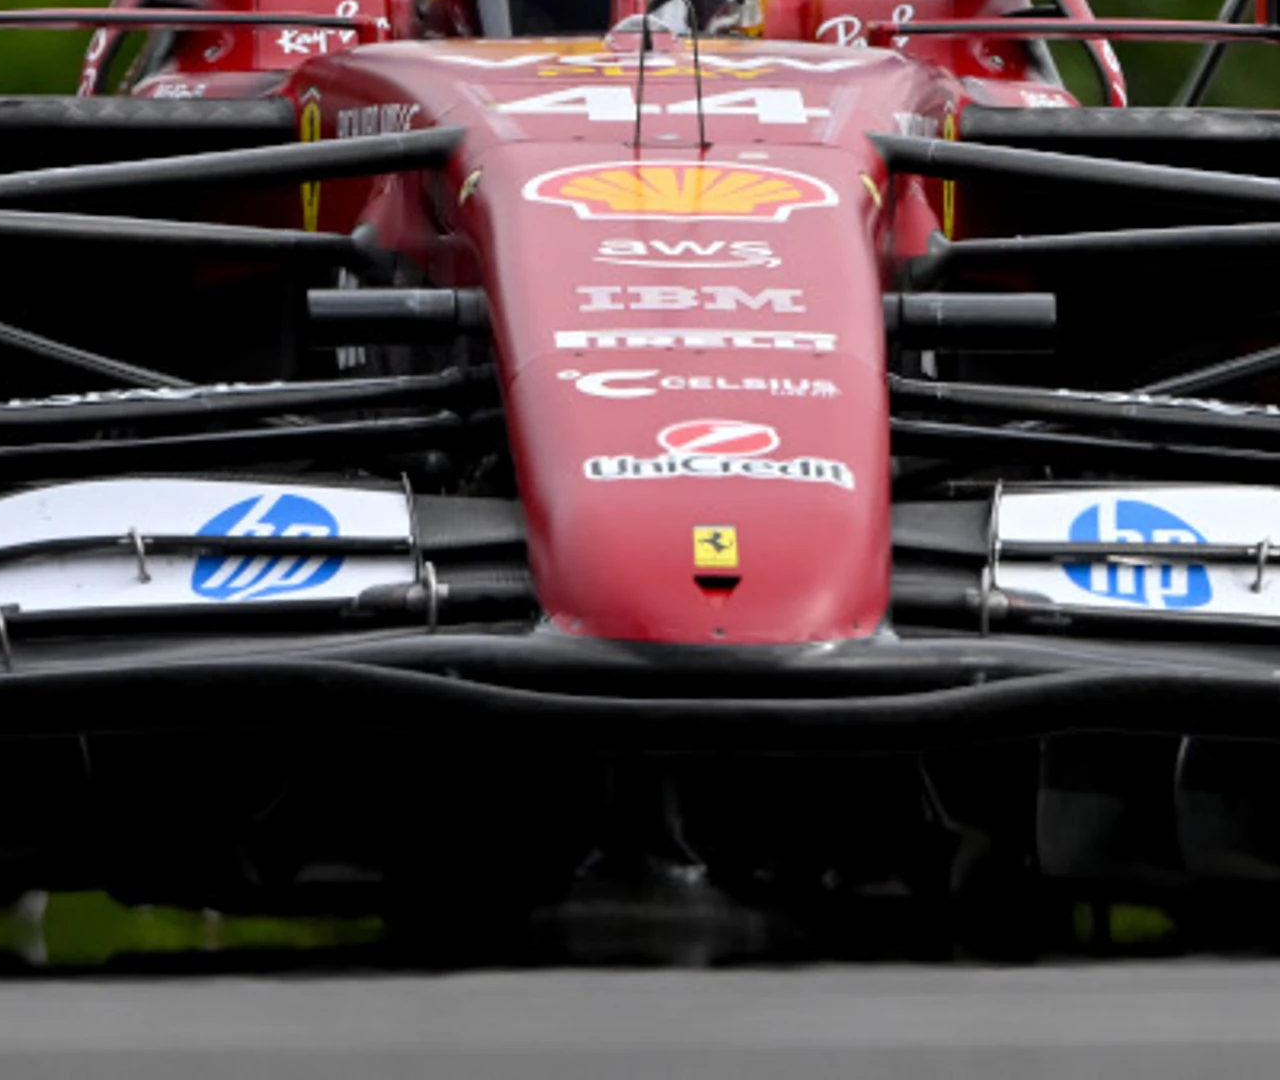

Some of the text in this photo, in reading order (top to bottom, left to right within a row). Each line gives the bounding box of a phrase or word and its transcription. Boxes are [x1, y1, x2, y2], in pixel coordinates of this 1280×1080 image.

[492, 85, 833, 124] 44
[597, 237, 775, 257] aws
[576, 285, 807, 313] IBM
[554, 329, 839, 351] PIRELLI
[582, 456, 856, 492] UniCredit
[202, 494, 334, 602] hp
[1085, 498, 1200, 610] hp
